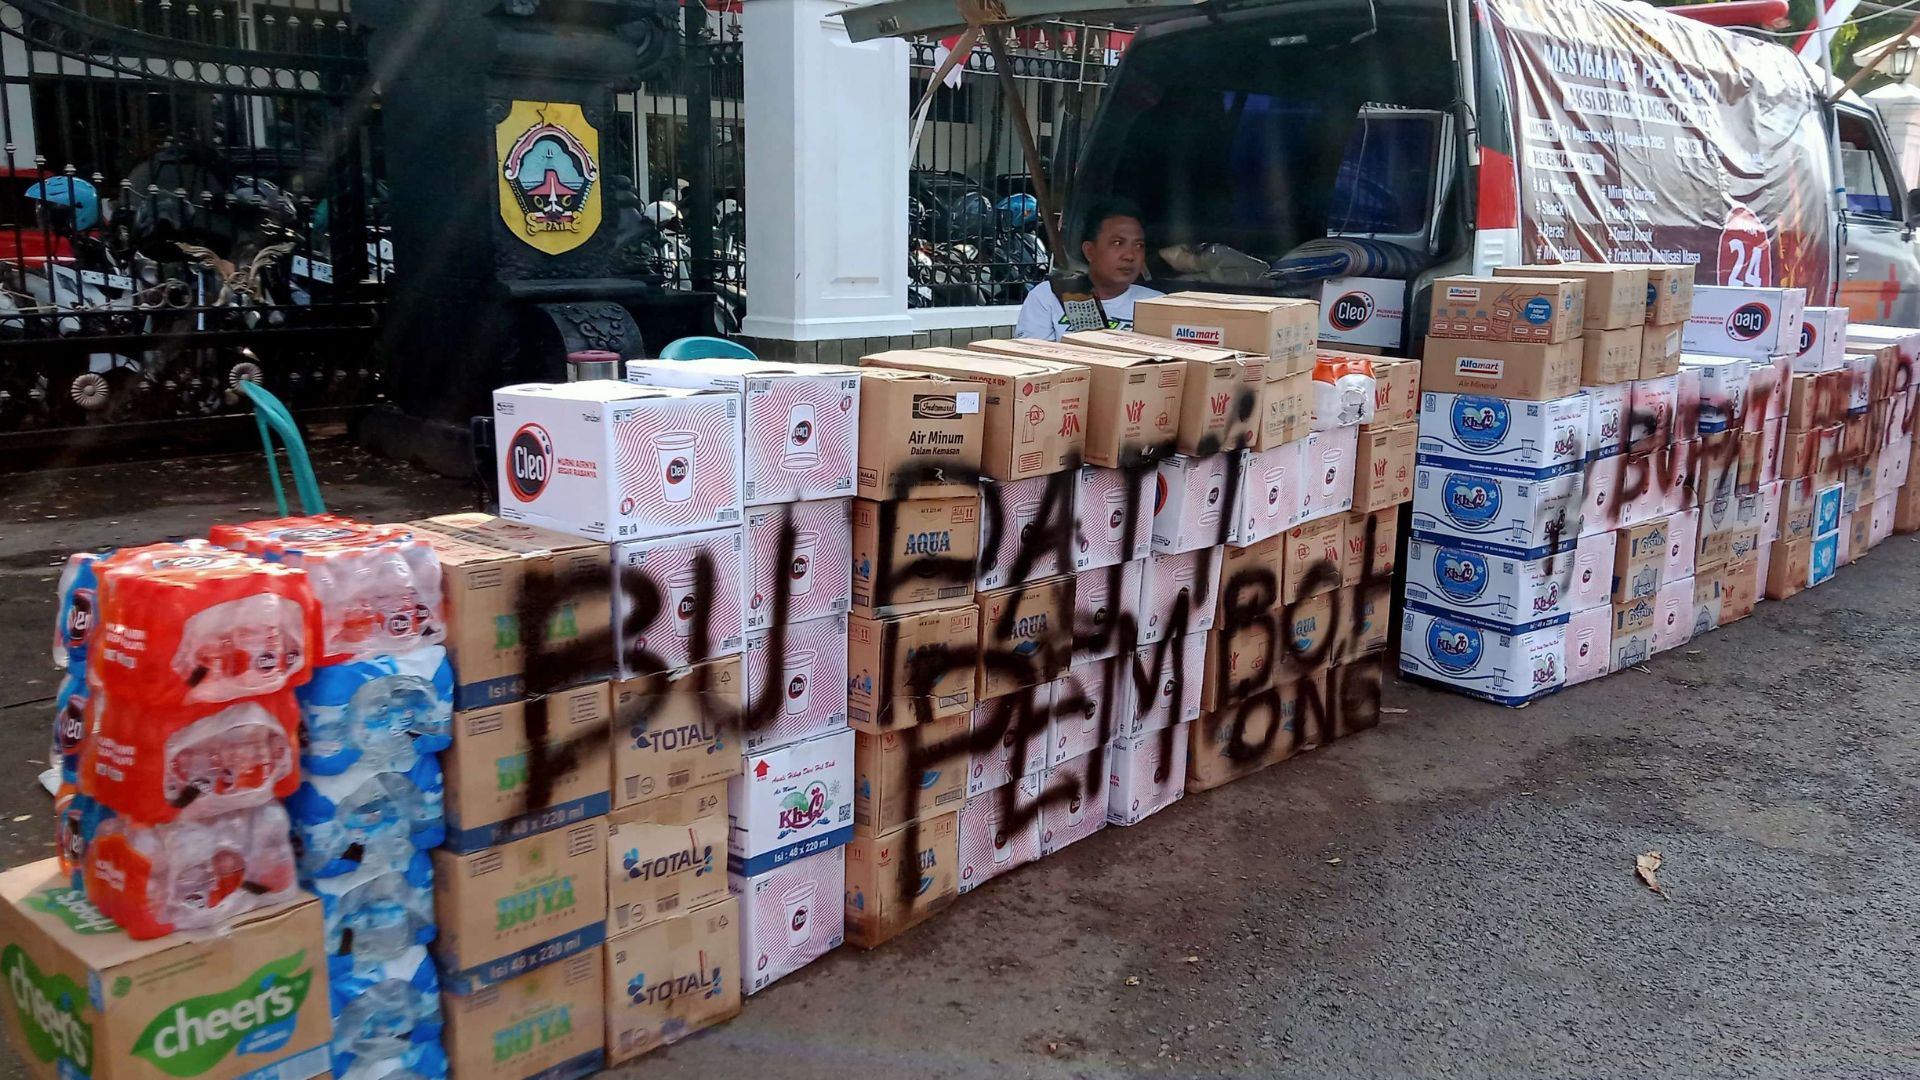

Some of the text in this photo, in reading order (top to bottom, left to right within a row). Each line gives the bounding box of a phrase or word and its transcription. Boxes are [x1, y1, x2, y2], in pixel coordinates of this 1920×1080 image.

[1597, 92, 1632, 115] DEMO
[1541, 199, 1564, 216] Snack
[1543, 222, 1565, 239] Beras
[1632, 249, 1651, 263] Untuk
[1682, 250, 1701, 264] Massa
[1729, 238, 1762, 287] 24
[1449, 288, 1477, 296] Alfamart
[1338, 301, 1365, 321] Cleo
[1735, 312, 1762, 331] Cleo
[1176, 327, 1220, 341] Alfamart
[1460, 359, 1499, 371] Alfamart
[1211, 392, 1230, 415] Vit
[1375, 382, 1392, 410] Vit
[1126, 400, 1145, 422] Vit
[908, 430, 964, 444] Air Minum
[910, 446, 960, 456] Dalam Kemasan
[514, 446, 545, 481] Cleo
[670, 465, 687, 477] Cleo
[1374, 458, 1387, 478] Vit
[904, 530, 950, 556] AQUA
[793, 562, 807, 574] Cleo
[488, 683, 506, 699] Isi
[791, 681, 805, 693] Cleo
[542, 809, 565, 827] 220
[568, 803, 584, 820] ml
[774, 853, 784, 863] Isi
[806, 840, 819, 853] 220
[820, 836, 829, 848] ml
[564, 935, 581, 951] ml
[10, 952, 87, 1068] cheers
[154, 983, 294, 1059] cheers
